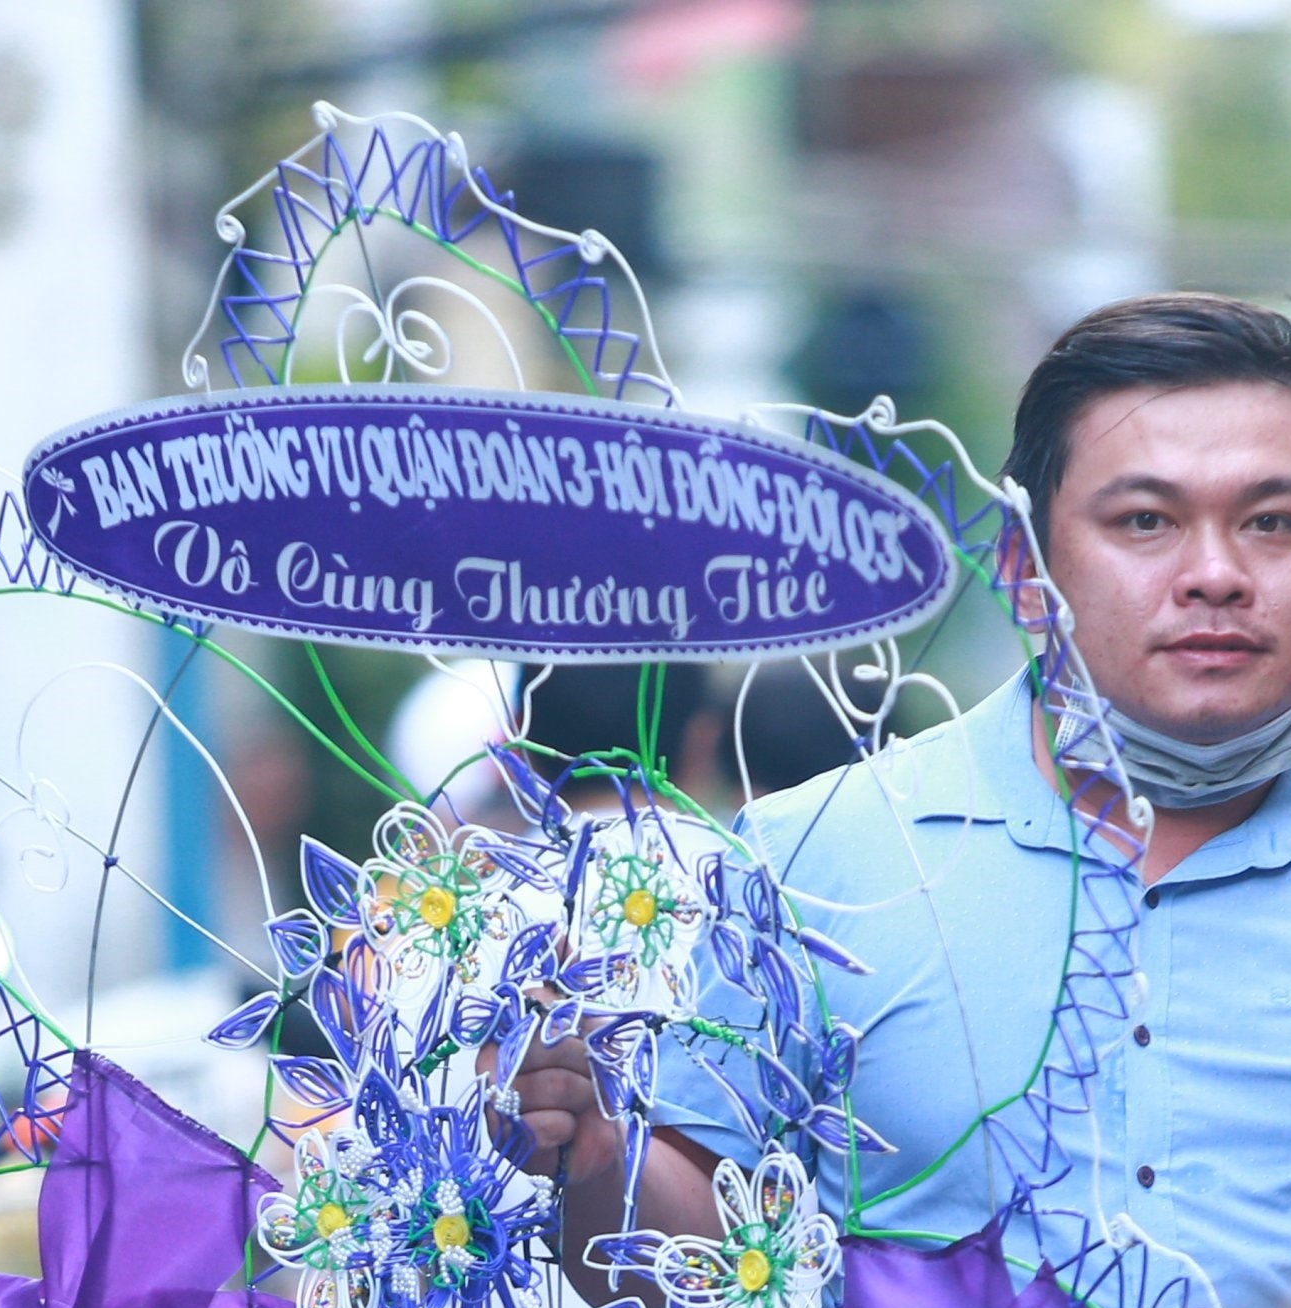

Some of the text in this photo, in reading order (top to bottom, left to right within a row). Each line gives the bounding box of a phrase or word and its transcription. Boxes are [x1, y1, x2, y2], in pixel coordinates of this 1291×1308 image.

[81, 442, 168, 529] BAN
[161, 412, 310, 510] THƯỜNG
[304, 426, 362, 513] VỤ
[361, 413, 463, 510] QUẬN
[455, 418, 566, 504] ĐOÀN
[668, 435, 776, 536] ĐỒNG
[773, 470, 847, 567] ĐỘI
[153, 520, 836, 640] Vô Cùng Thương Tiếc
